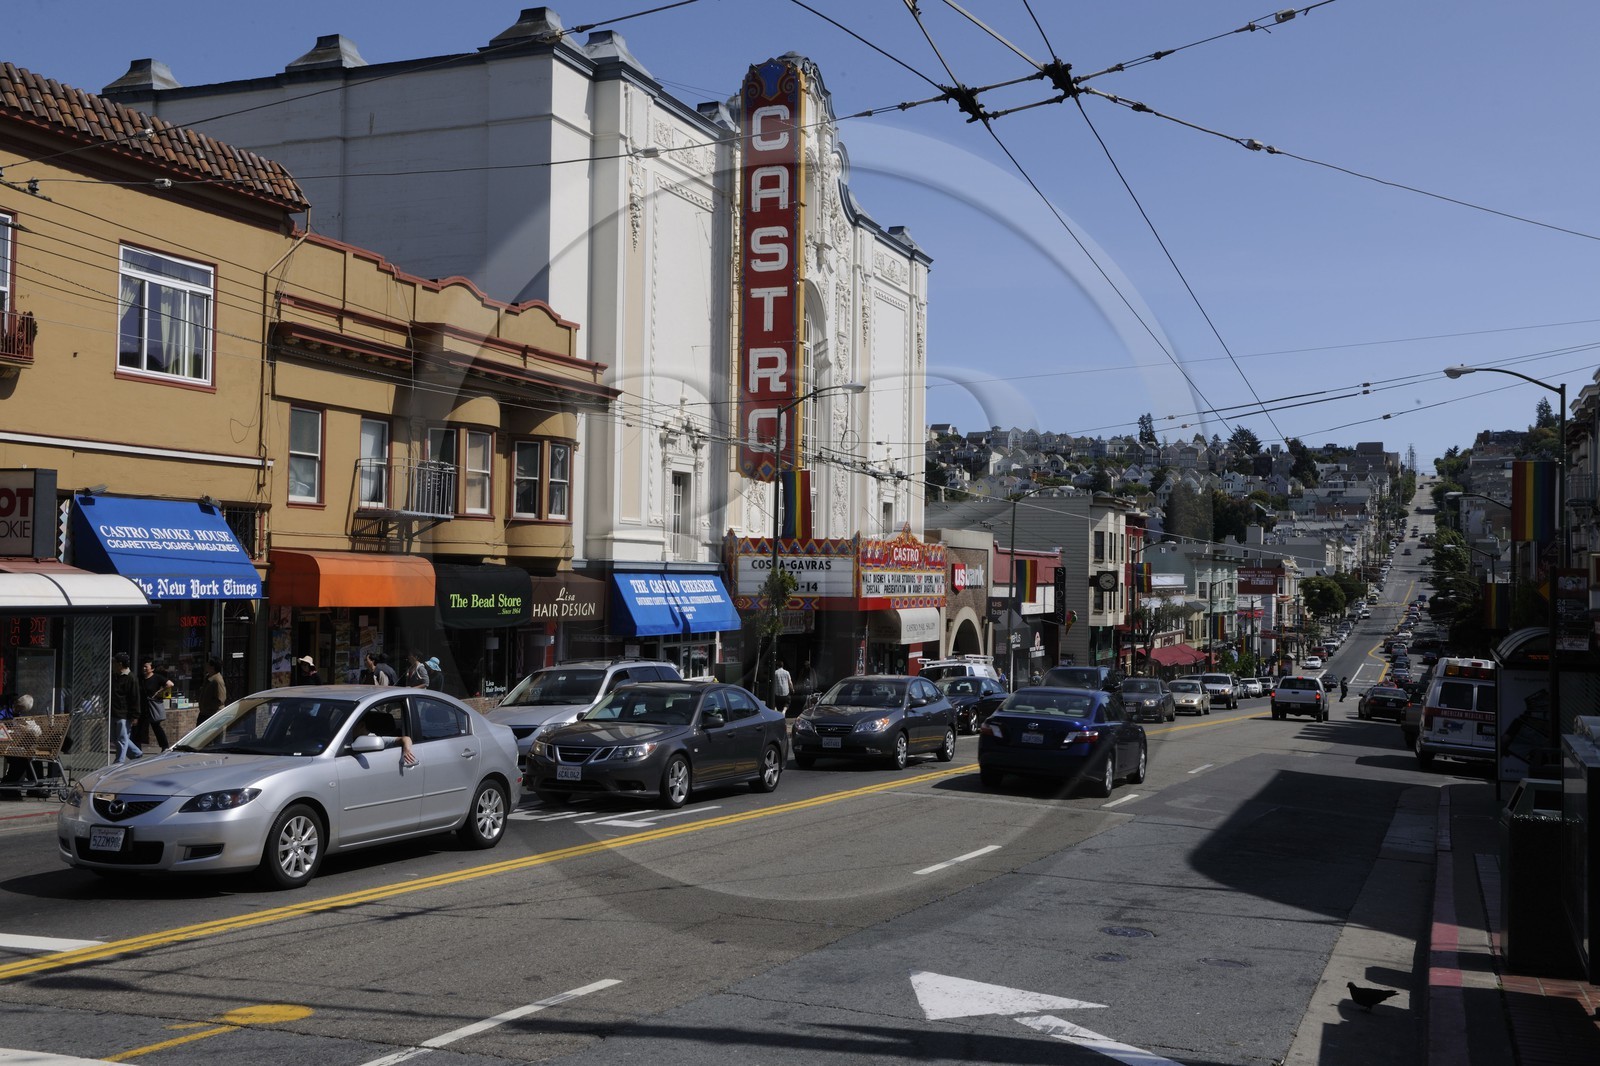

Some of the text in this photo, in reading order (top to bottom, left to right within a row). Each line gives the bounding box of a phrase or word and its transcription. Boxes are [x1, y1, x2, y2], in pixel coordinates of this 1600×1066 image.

[747, 104, 790, 454] CASTRO
[99, 525, 233, 543] CASTRO SMOKE HOUSE
[893, 547, 920, 562] CASTRO
[751, 559, 832, 570] COSA-GAVRAS
[629, 579, 718, 594] THE CASTRO CHEESERY
[873, 574, 886, 584] DISNEY
[157, 578, 186, 598] New
[190, 578, 219, 599] York
[223, 577, 258, 597] Times
[555, 586, 576, 602] Lisa
[866, 584, 881, 594] SPECIAL
[450, 593, 522, 608] The Bead Store
[533, 602, 596, 618] HAIR DESIGN
[1441, 709, 1463, 718] AMERICAN
[1464, 711, 1485, 720] MEDICAL
